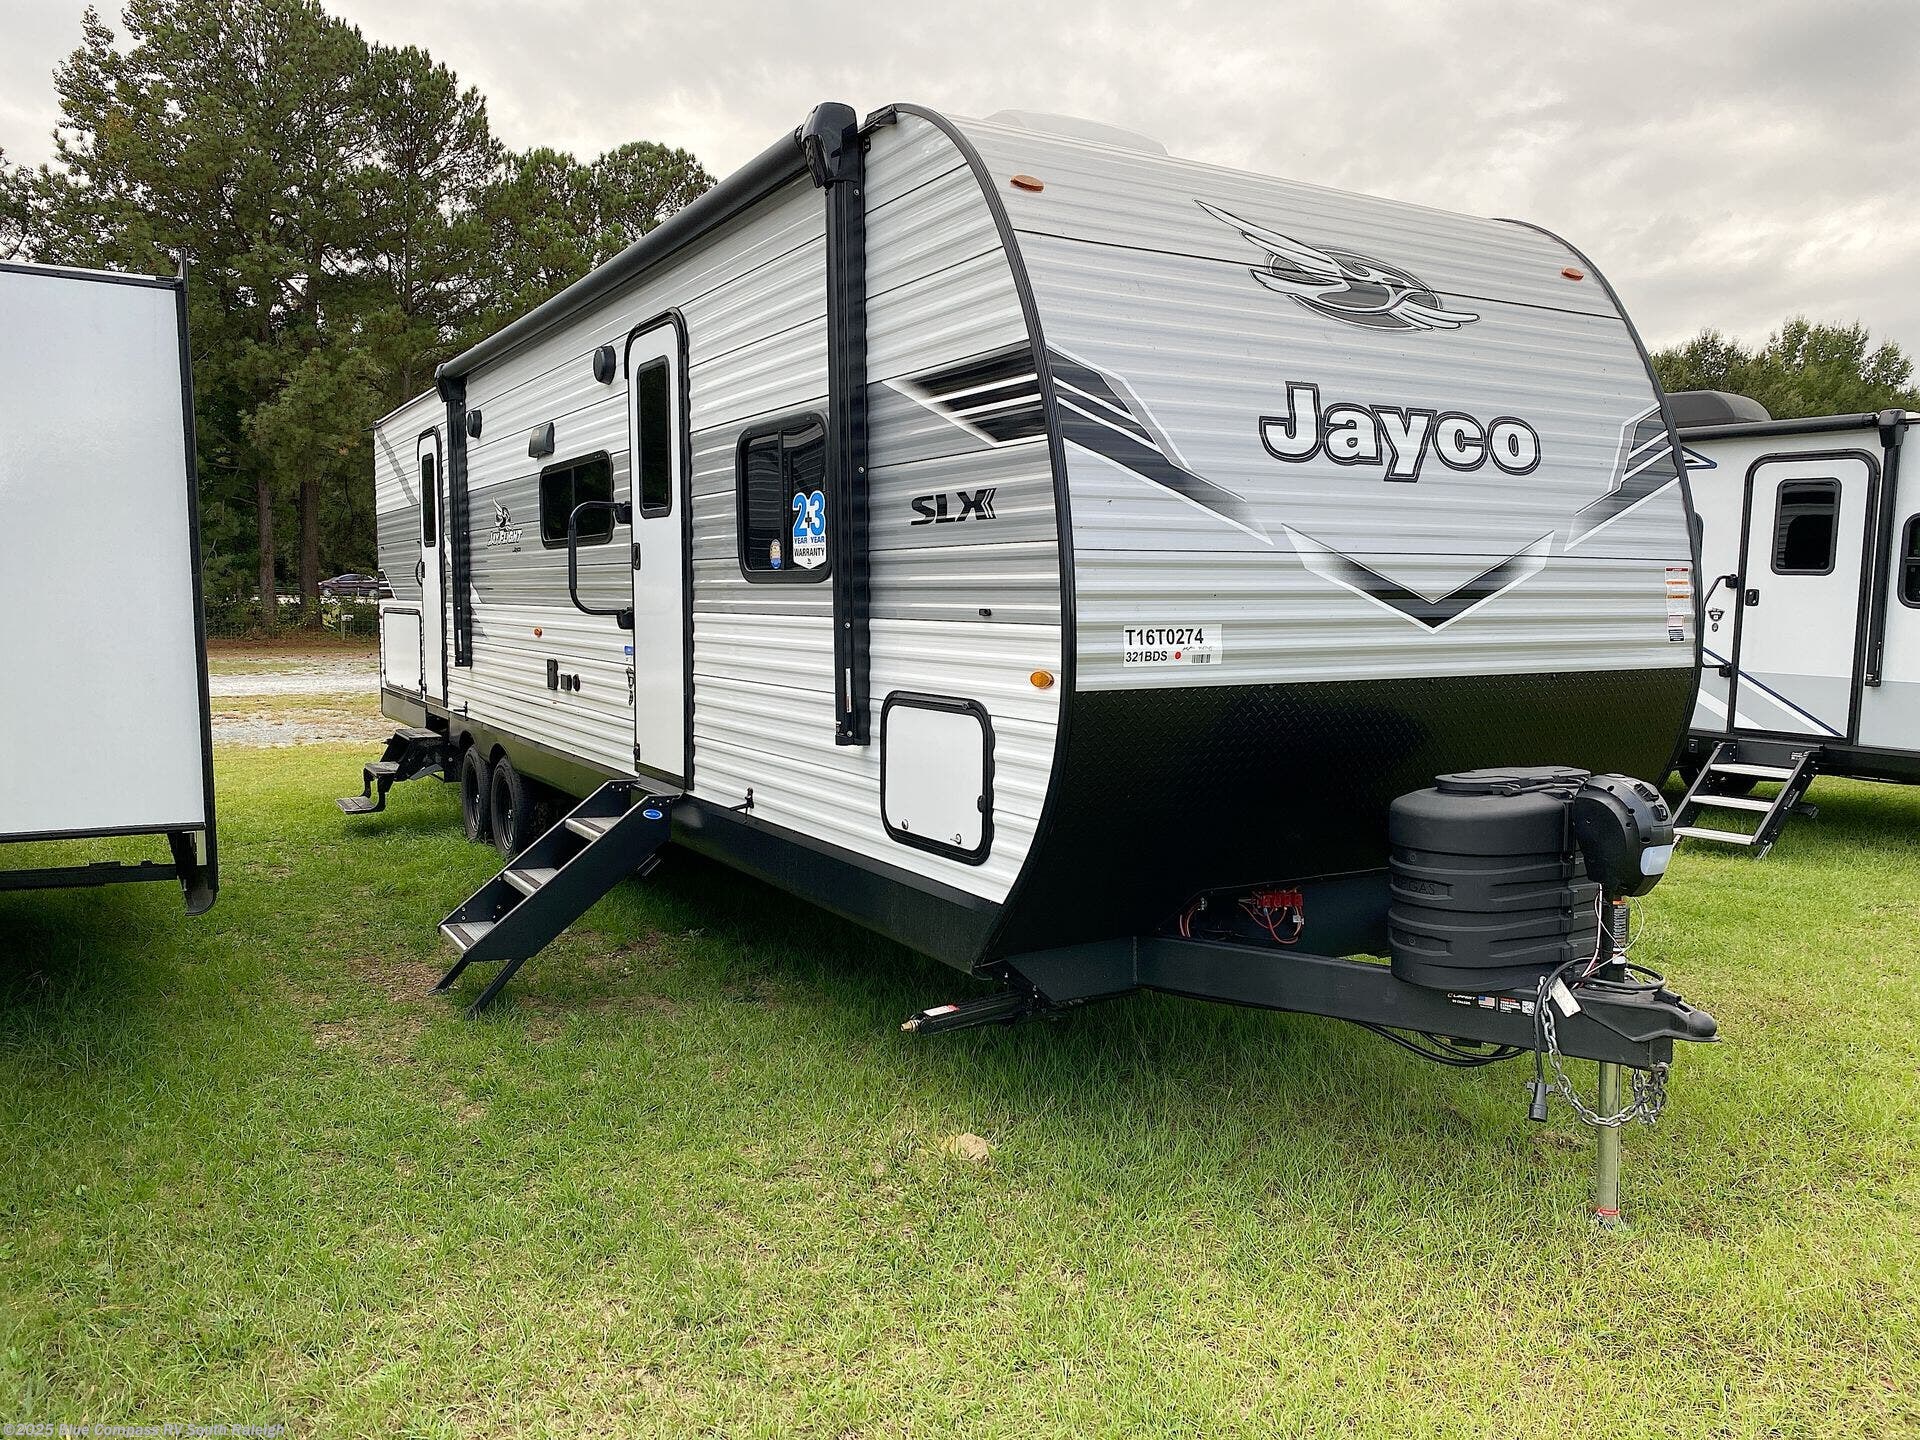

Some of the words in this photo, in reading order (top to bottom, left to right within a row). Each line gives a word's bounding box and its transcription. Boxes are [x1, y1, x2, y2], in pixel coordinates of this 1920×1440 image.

[1259, 381, 1541, 483] Jayco
[911, 488, 997, 525] SLX
[794, 536, 808, 544] YEAR
[810, 536, 825, 544] YEAR
[794, 547, 825, 557] WARRANTY
[1125, 628, 1204, 645] T16T0274
[1125, 651, 1168, 662] 321BDS
